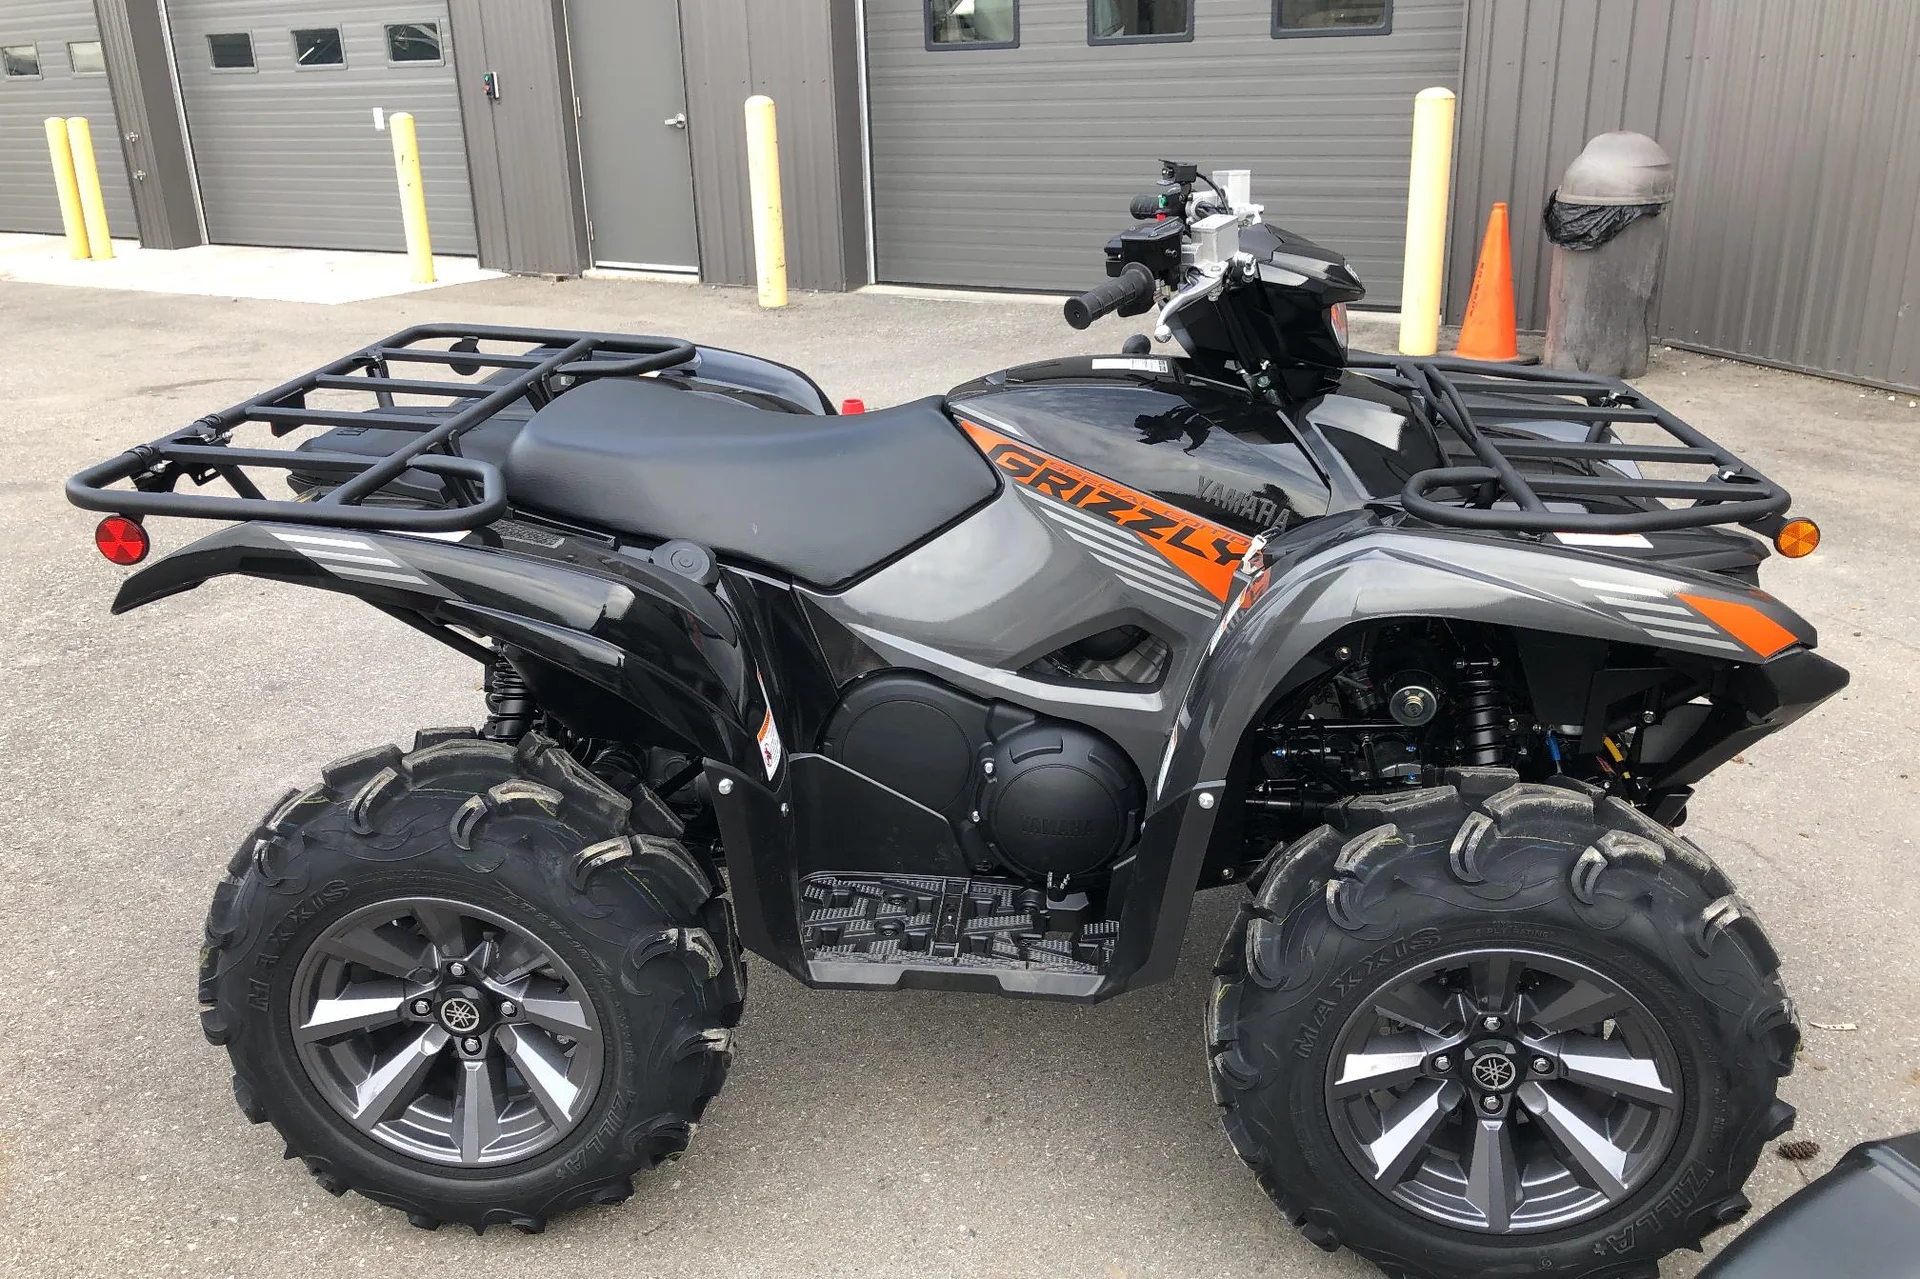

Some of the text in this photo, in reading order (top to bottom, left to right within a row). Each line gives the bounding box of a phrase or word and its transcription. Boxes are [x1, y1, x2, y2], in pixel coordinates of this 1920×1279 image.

[988, 443, 1250, 566] GRIZZLY
[1048, 461, 1252, 547] SPECIAL EDITIO
[1196, 475, 1290, 533] YAMAHA
[1019, 813, 1097, 838] YAMAHA
[246, 879, 350, 1012] MAXXIS
[1294, 926, 1441, 1058] MAXXIS
